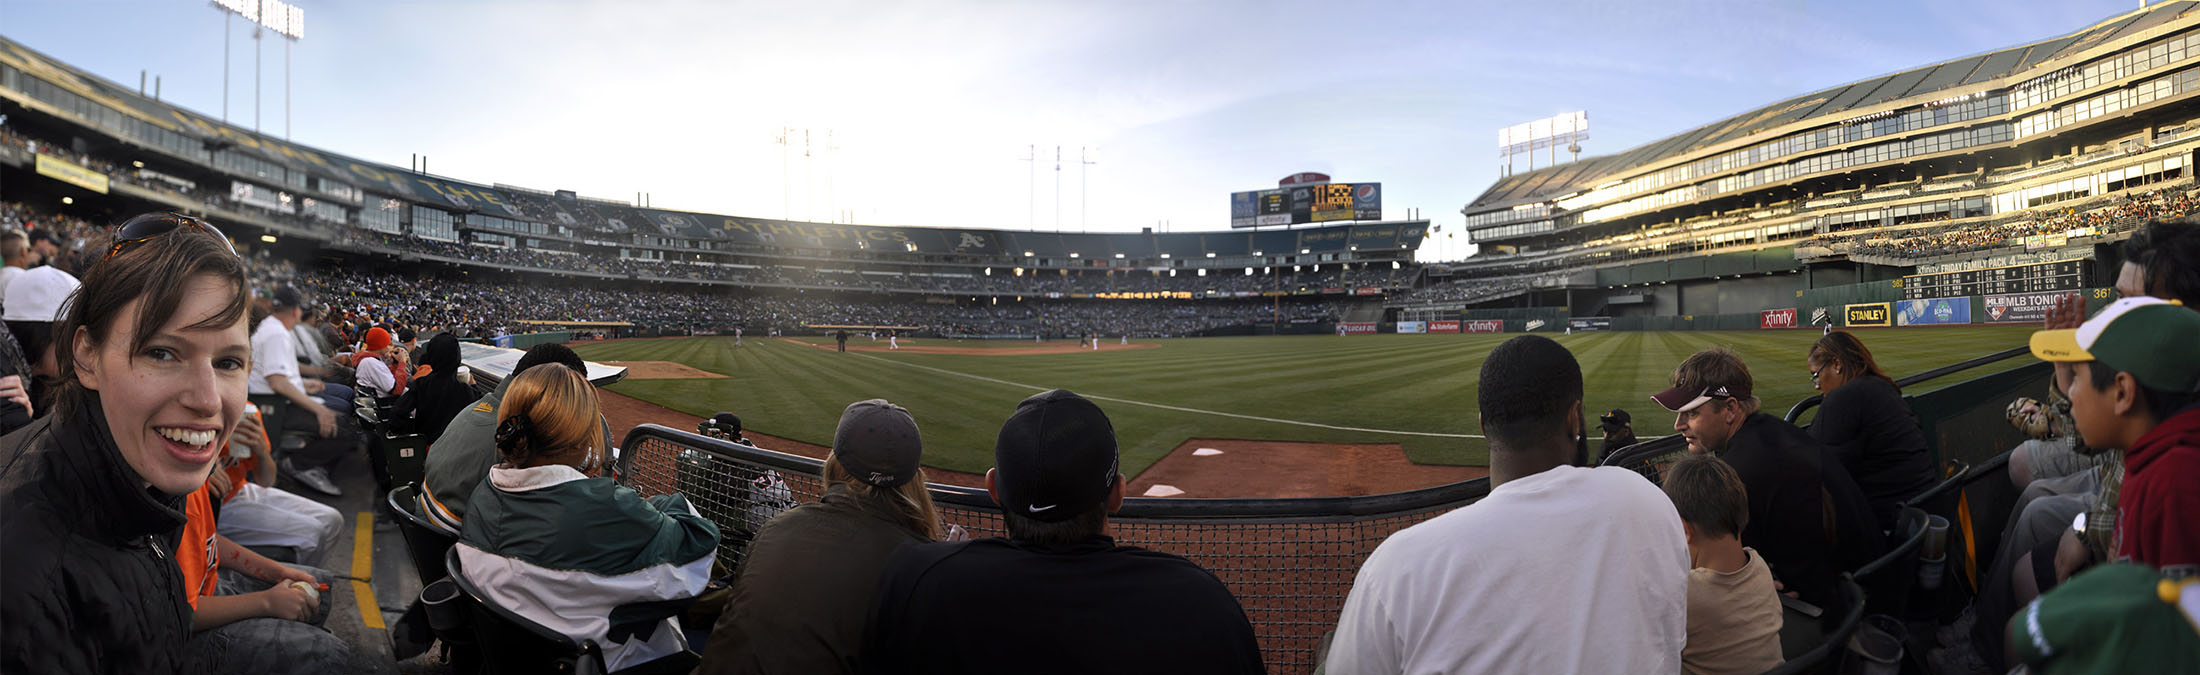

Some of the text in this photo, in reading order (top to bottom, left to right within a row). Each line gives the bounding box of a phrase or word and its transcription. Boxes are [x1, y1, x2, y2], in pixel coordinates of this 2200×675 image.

[418, 179, 504, 206] THE
[724, 218, 911, 242] ATHLETICS
[2040, 252, 2058, 263] $50
[1941, 262, 1963, 273] FRIDAY
[1963, 259, 1988, 272] FAMILY
[1988, 256, 2007, 269] PACK
[2009, 255, 2016, 266] 4
[1892, 280, 1903, 288] 362
[1986, 297, 2005, 306] MLB
[2006, 297, 2027, 307] MLB
[1765, 312, 1793, 328] xfinity
[1850, 309, 1885, 321] STANLEY
[1468, 321, 1498, 333] xfinity
